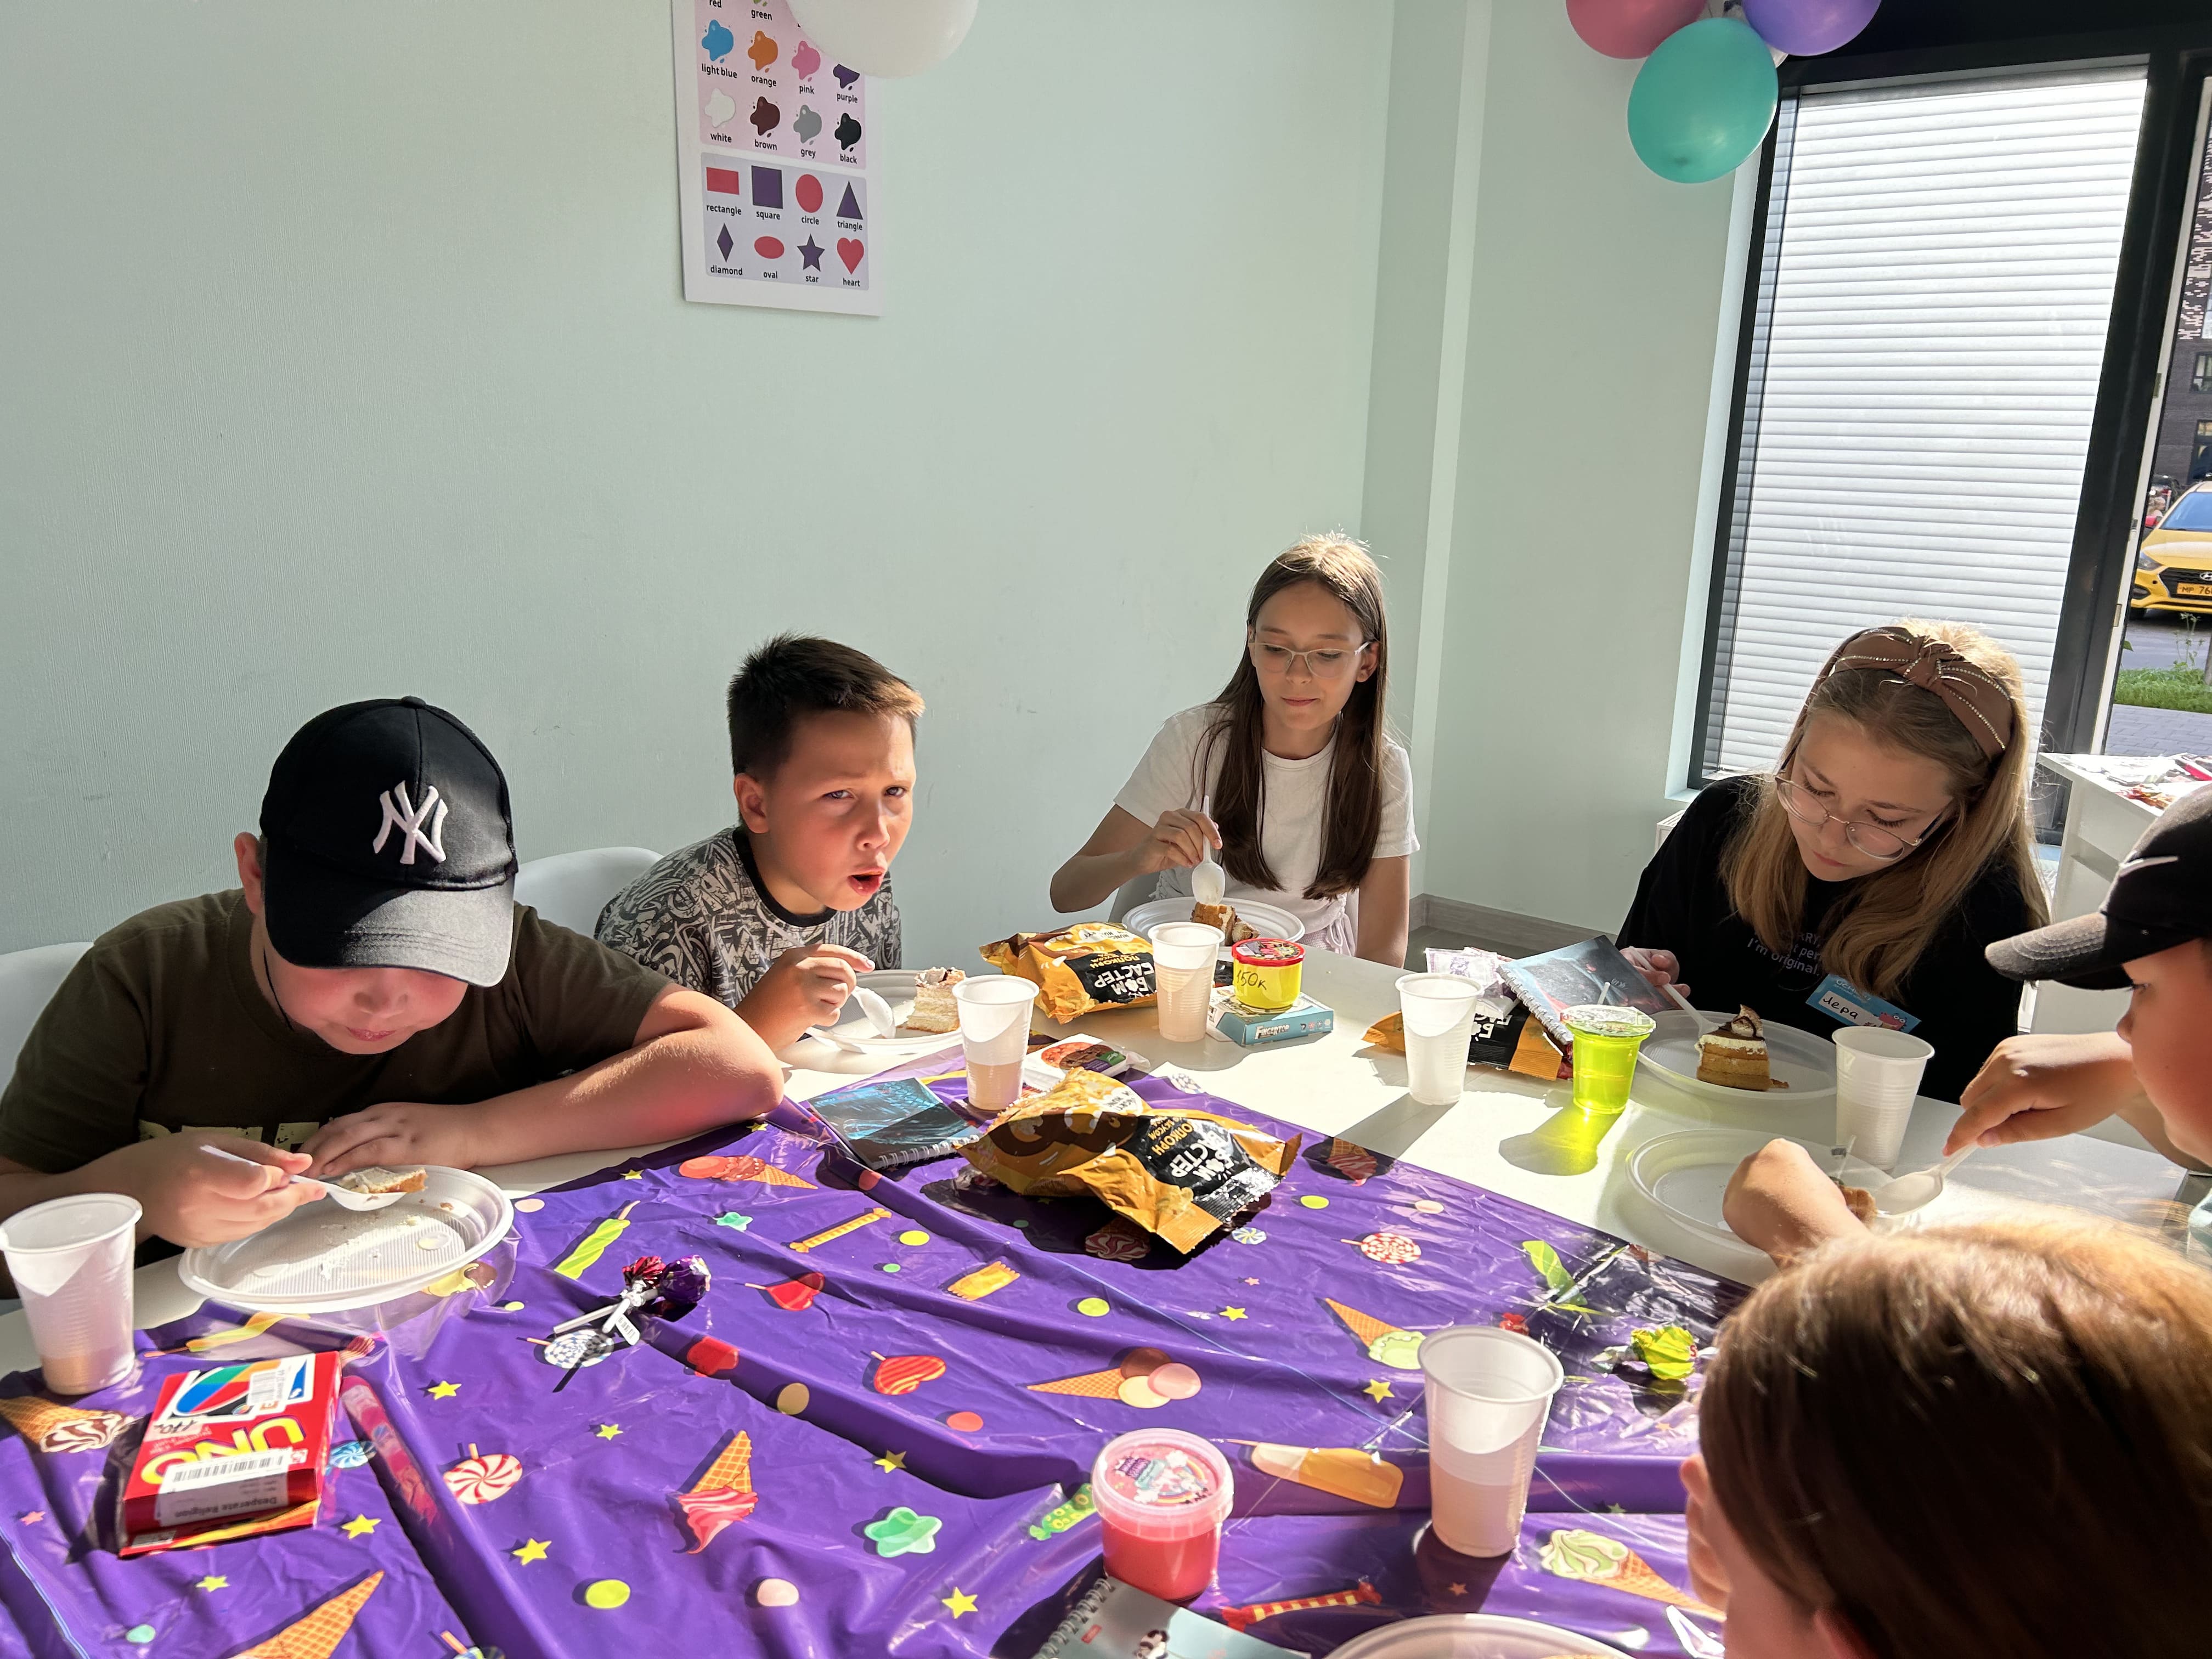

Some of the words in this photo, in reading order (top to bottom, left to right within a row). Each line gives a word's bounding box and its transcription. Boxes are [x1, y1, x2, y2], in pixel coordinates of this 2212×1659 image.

[709, 0, 721, 8] red
[751, 9, 772, 21] green
[702, 64, 720, 75] light
[721, 65, 737, 78] blue
[751, 75, 777, 87] orange
[799, 85, 815, 94] pink
[837, 93, 858, 104] purple
[710, 133, 732, 143] white
[754, 139, 777, 151] brown
[800, 148, 816, 159] grey
[840, 154, 857, 163] black
[706, 204, 742, 216] rectangle
[756, 211, 780, 220] square
[801, 215, 819, 225] circle
[837, 221, 863, 231] triangle
[710, 265, 743, 275] diamond
[763, 270, 778, 279] oval
[805, 274, 819, 283] star
[843, 278, 860, 286] heart
[2199, 586, 2212, 595] 76
[1090, 956, 1140, 969] ПОПКОРН
[1094, 962, 1155, 988] БАСТЕР
[140, 1415, 306, 1485] UNO
